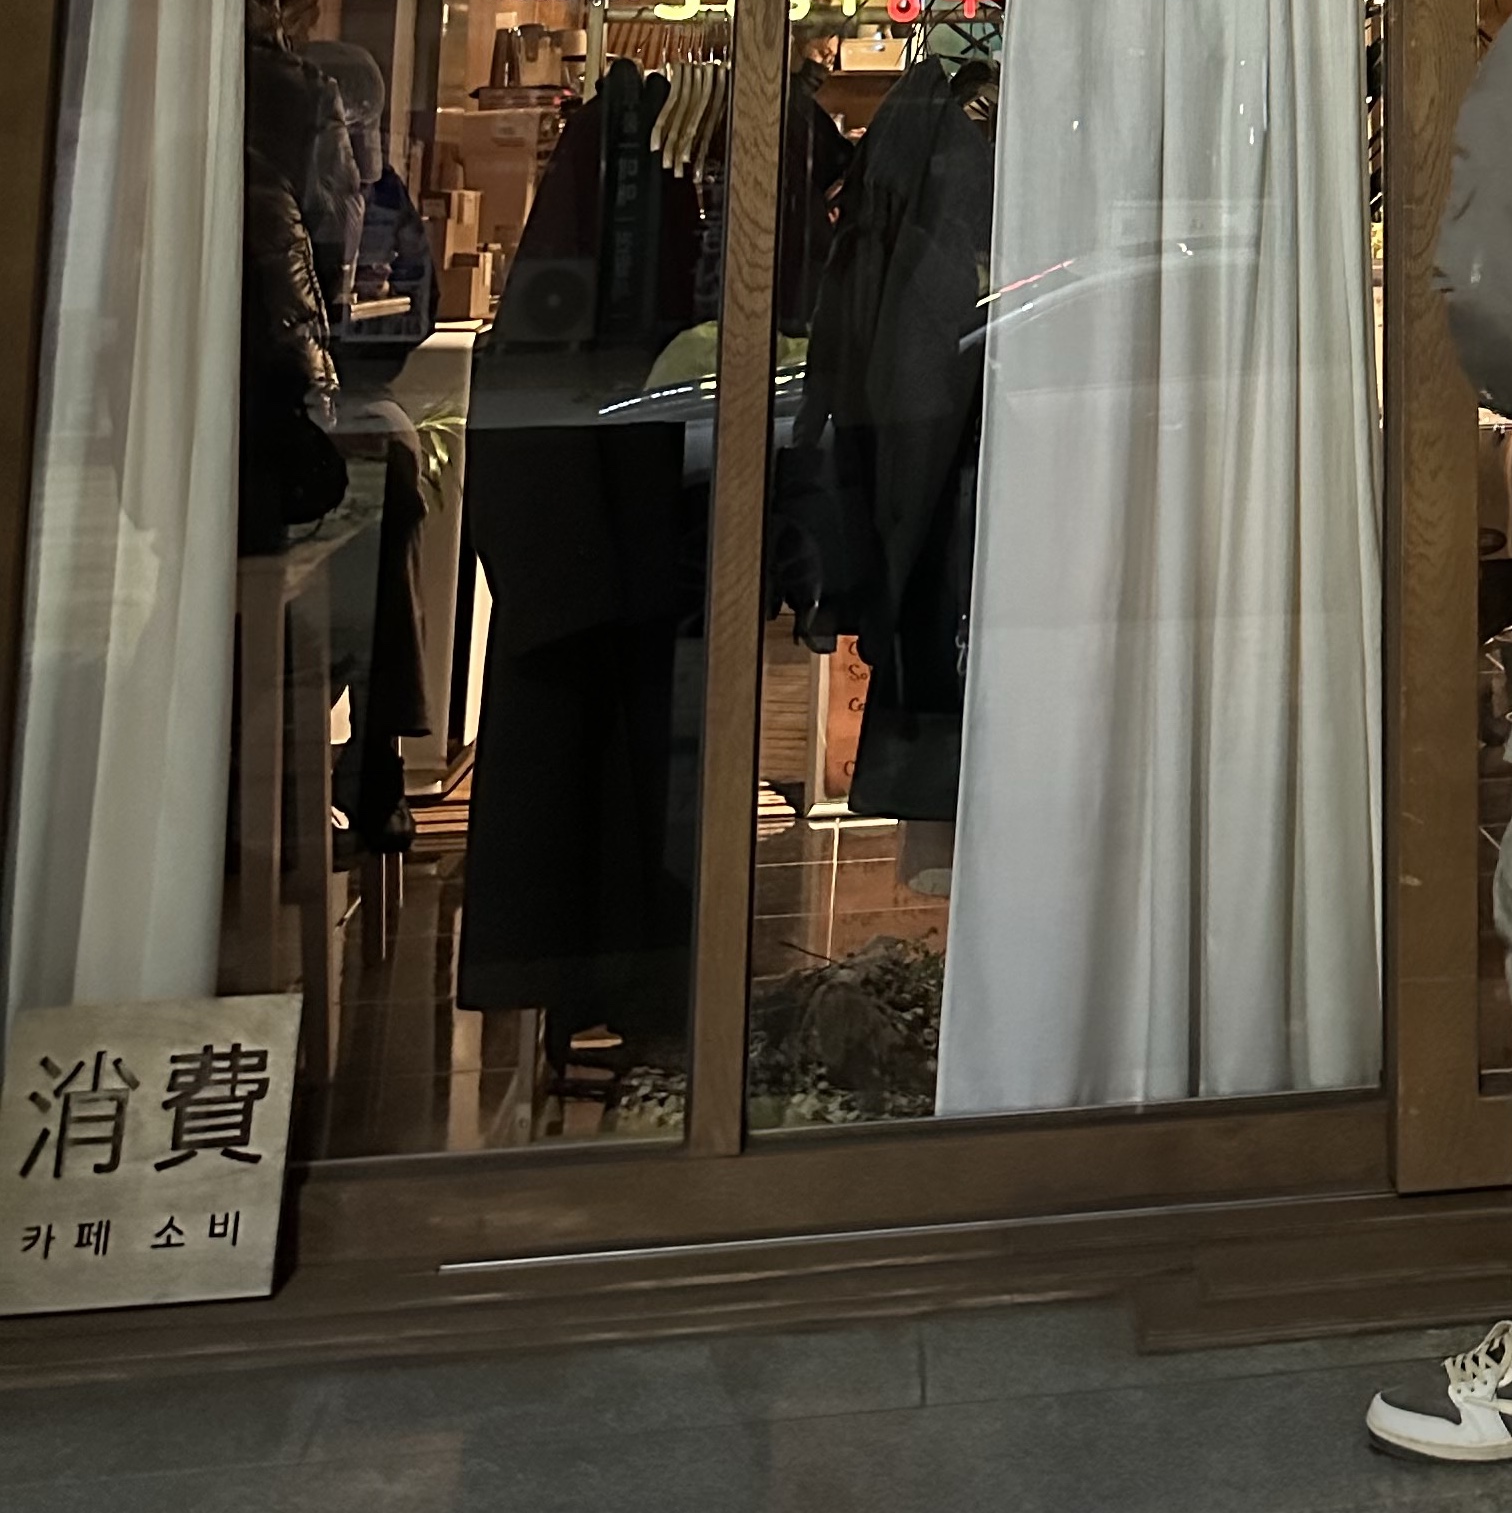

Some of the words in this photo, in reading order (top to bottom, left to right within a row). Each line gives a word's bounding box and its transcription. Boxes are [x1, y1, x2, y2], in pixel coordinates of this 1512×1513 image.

[18, 1043, 271, 1179] 消費
[22, 1219, 111, 1260] 카페
[151, 1211, 240, 1250] 소비
